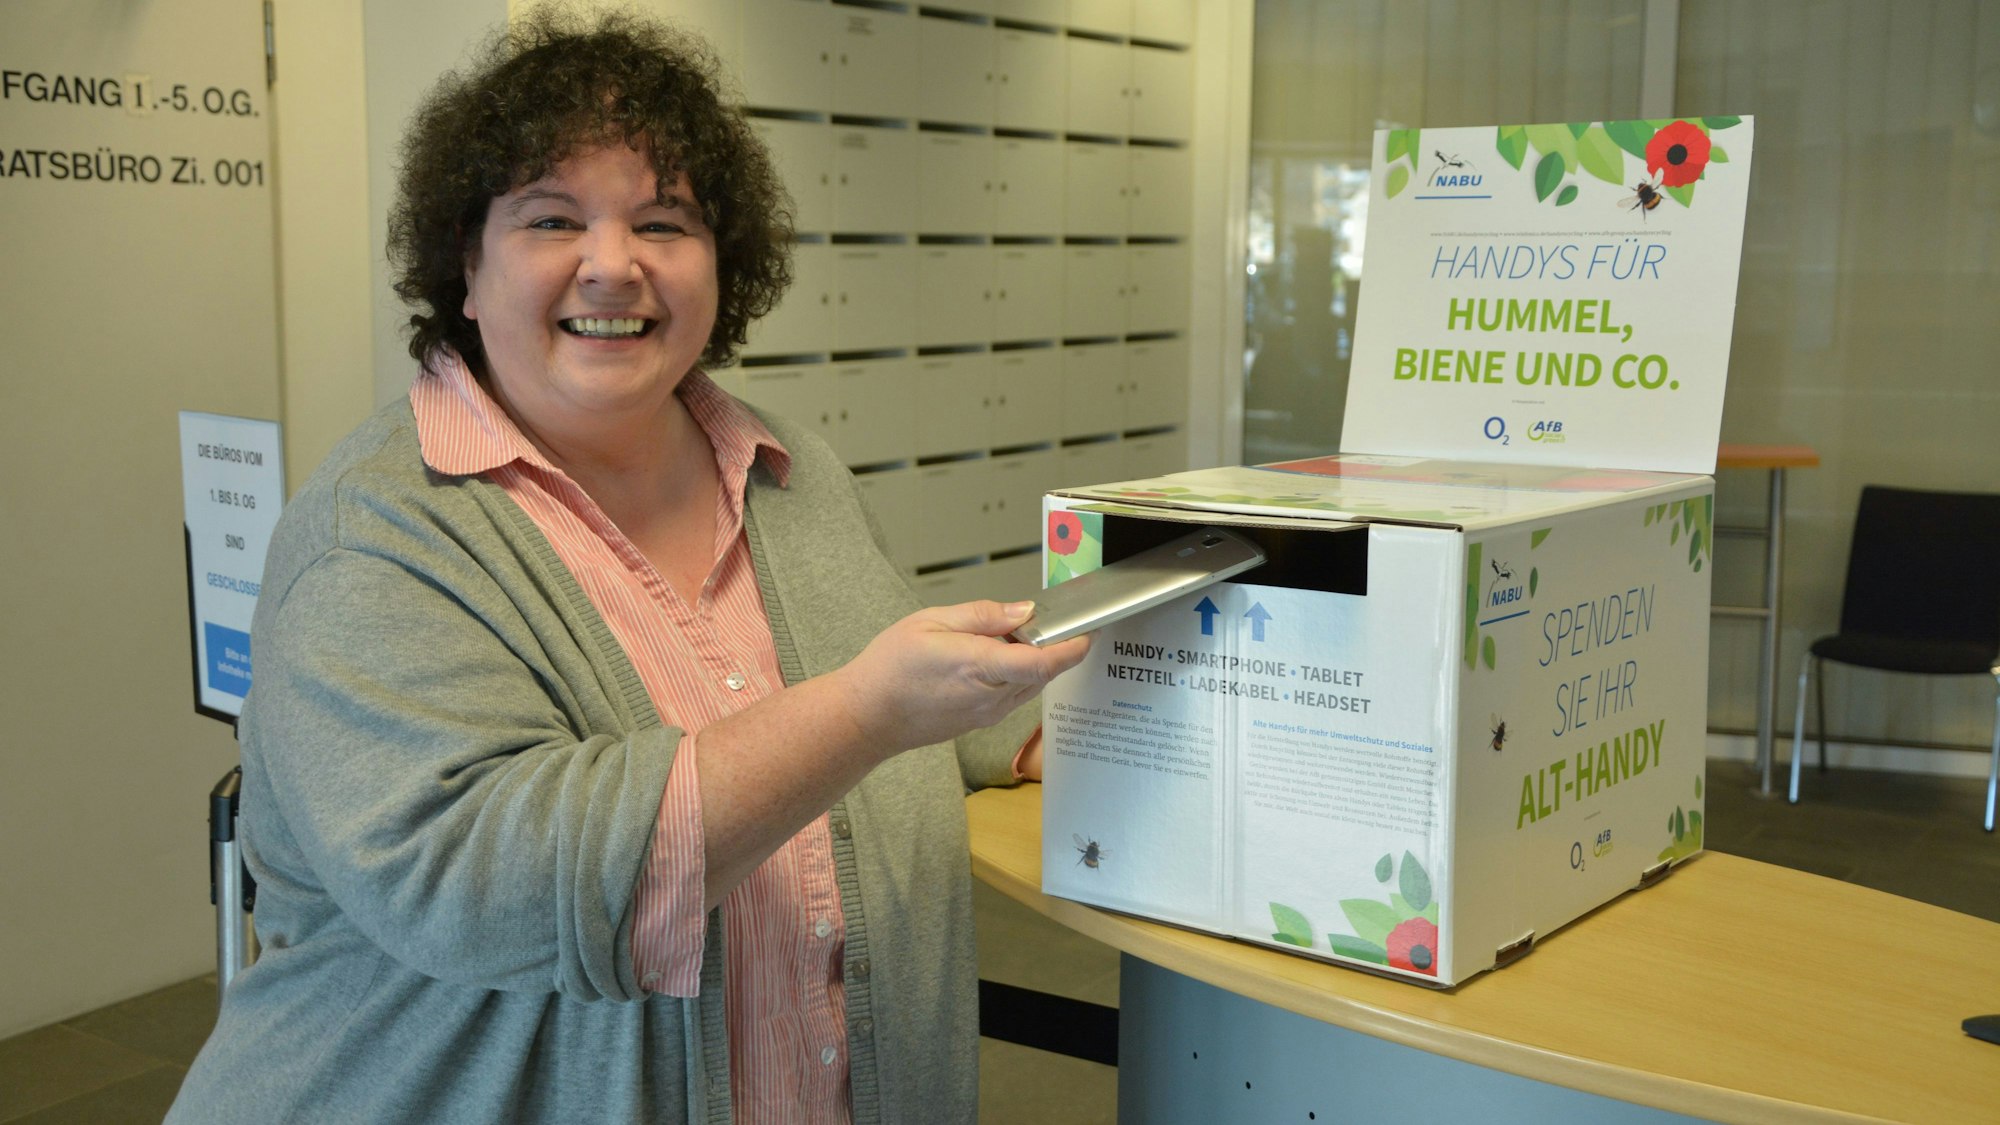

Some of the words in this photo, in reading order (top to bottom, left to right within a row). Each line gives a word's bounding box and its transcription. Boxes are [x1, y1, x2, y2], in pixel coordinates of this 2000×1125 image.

[2, 70, 122, 107] FGANG
[170, 156, 206, 185] Zi.
[214, 158, 264, 187] 001
[1435, 174, 1483, 188] NABU
[1430, 244, 1580, 281] HANDYS
[1587, 237, 1667, 281] FÜR
[1447, 297, 1634, 343] HUMMEL,
[1393, 348, 1506, 384] BIENE
[1515, 352, 1603, 388] UND
[1611, 353, 1680, 391] CO.
[1533, 420, 1563, 433] AfB
[197, 442, 212, 459] DIE
[213, 444, 243, 464] BÜROS
[243, 449, 264, 467] VOM
[209, 488, 217, 503] 1.
[218, 489, 232, 506] BIS
[234, 492, 242, 508] 5.
[242, 493, 257, 510] OG
[225, 533, 246, 551] SIND
[1491, 585, 1523, 608] NABU
[1538, 583, 1655, 668] SPENDEN
[1113, 641, 1165, 661] HANDY
[1176, 649, 1287, 678] SMARTPHONE
[1301, 665, 1364, 688] TABLET
[1107, 663, 1177, 687] NETZTEIL
[1189, 675, 1280, 702] LADEKABEL
[1294, 689, 1371, 714] HEADSET
[1552, 674, 1592, 738] SIE
[1595, 659, 1638, 722] IHR
[1053, 701, 1067, 710] Alle
[1068, 703, 1087, 713] Daten
[1161, 718, 1186, 731] Spende
[1111, 699, 1153, 713] Datenschutz
[1048, 712, 1069, 722] NABU
[1118, 723, 1143, 734] werden
[1251, 719, 1267, 728] Alte
[1268, 721, 1295, 734] Handys
[1296, 725, 1307, 734] für
[1308, 727, 1328, 737] mehr
[1329, 730, 1383, 745] Umweltschutz
[1384, 738, 1400, 747] und
[1400, 740, 1433, 752] Soziales
[1056, 747, 1075, 757] Daten
[1090, 752, 1110, 763] Ihrem
[1133, 760, 1152, 770] bevor
[1122, 746, 1151, 758] dennoch
[1152, 752, 1165, 761] alle
[1516, 719, 1666, 831] ALT-HANDY
[1596, 828, 1612, 847] AfB
